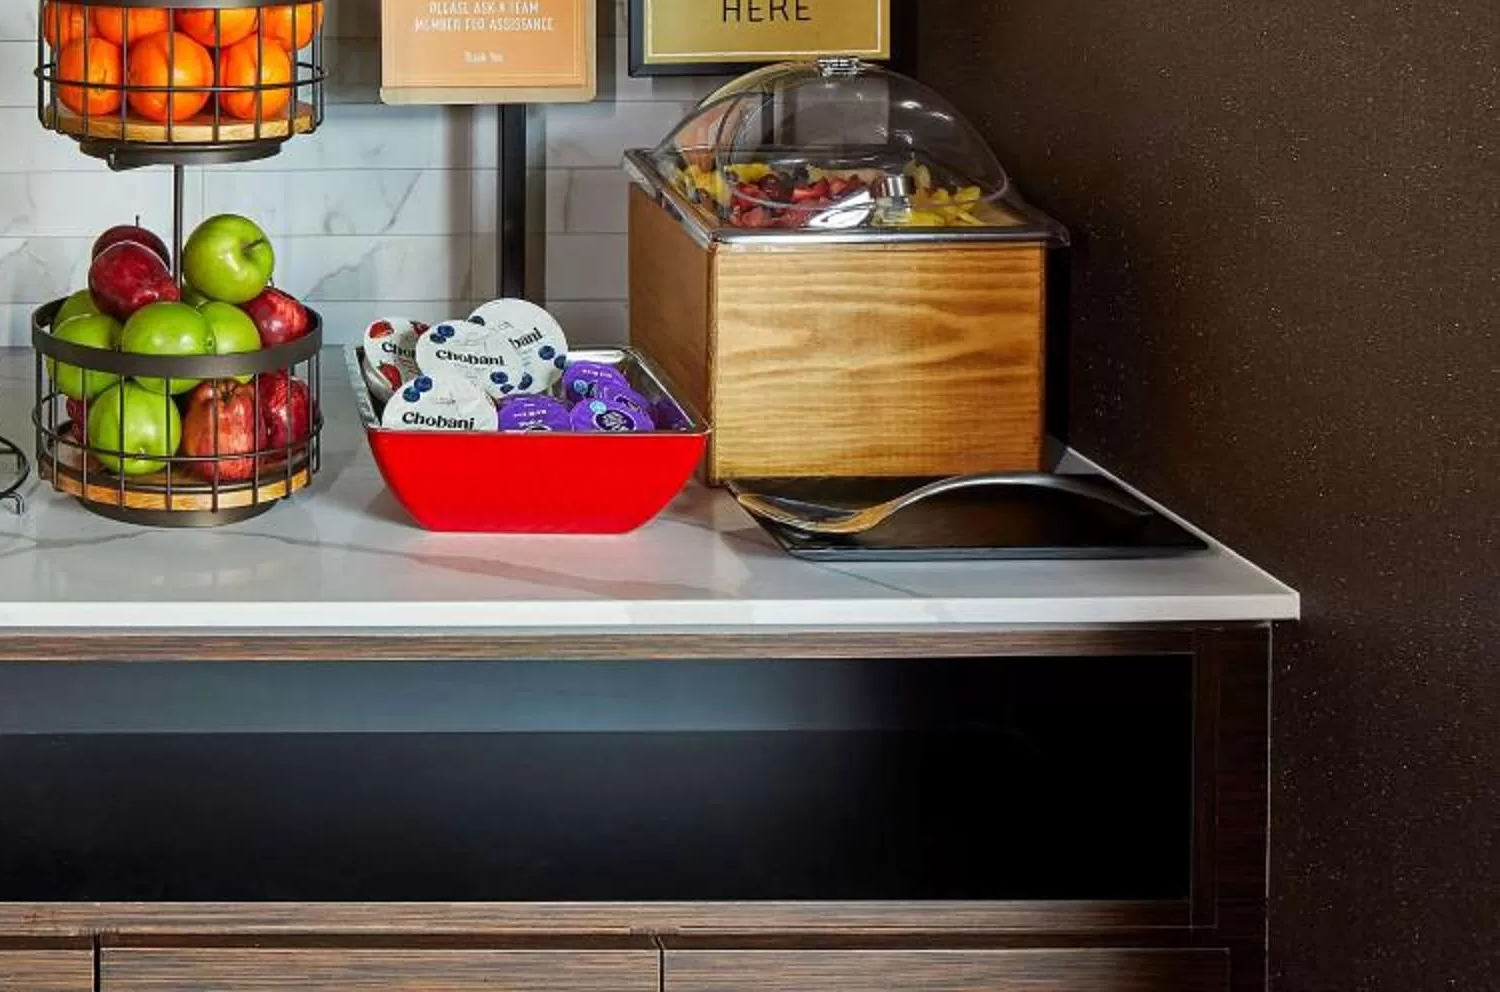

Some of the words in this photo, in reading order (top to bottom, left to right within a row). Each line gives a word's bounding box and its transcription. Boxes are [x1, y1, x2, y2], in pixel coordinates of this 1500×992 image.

[508, 326, 543, 349] bani
[435, 349, 505, 367] Chobani
[402, 411, 475, 431] Chobani
